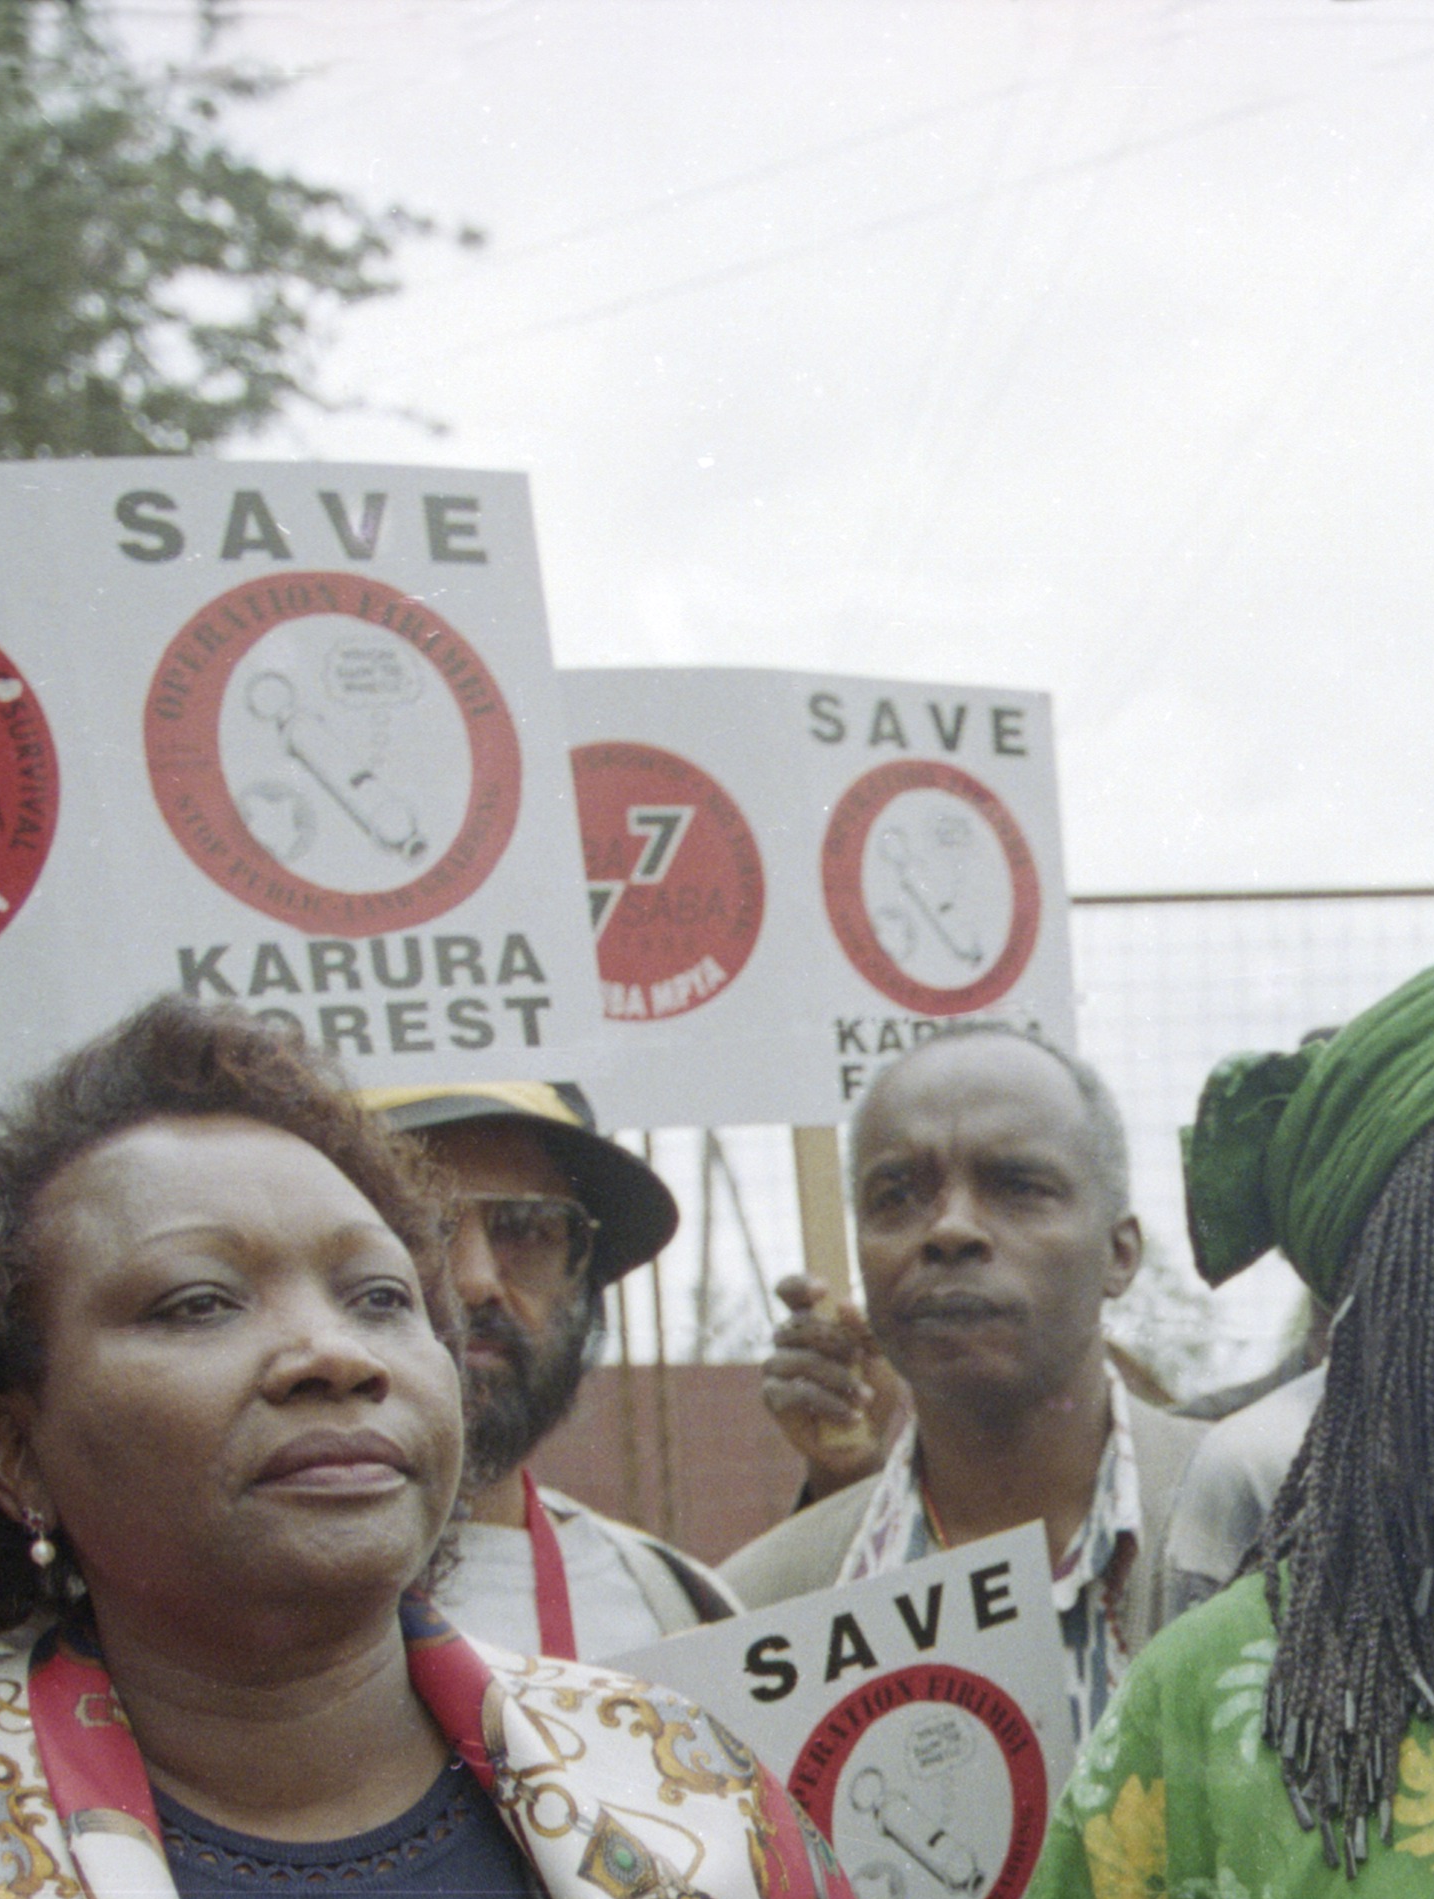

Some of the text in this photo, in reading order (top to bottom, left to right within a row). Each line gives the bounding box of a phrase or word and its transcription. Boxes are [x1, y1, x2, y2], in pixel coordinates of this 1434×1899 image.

[113, 488, 489, 566] SAVE
[807, 691, 1030, 757] SAVE
[0, 700, 45, 851] SURVIVAL
[627, 805, 697, 885] 7
[617, 885, 727, 929] SABA
[178, 931, 551, 1003] KARURA
[251, 994, 552, 1056] OREST
[742, 1561, 1019, 1703] SAVE
[793, 1677, 915, 1811] PERATION
